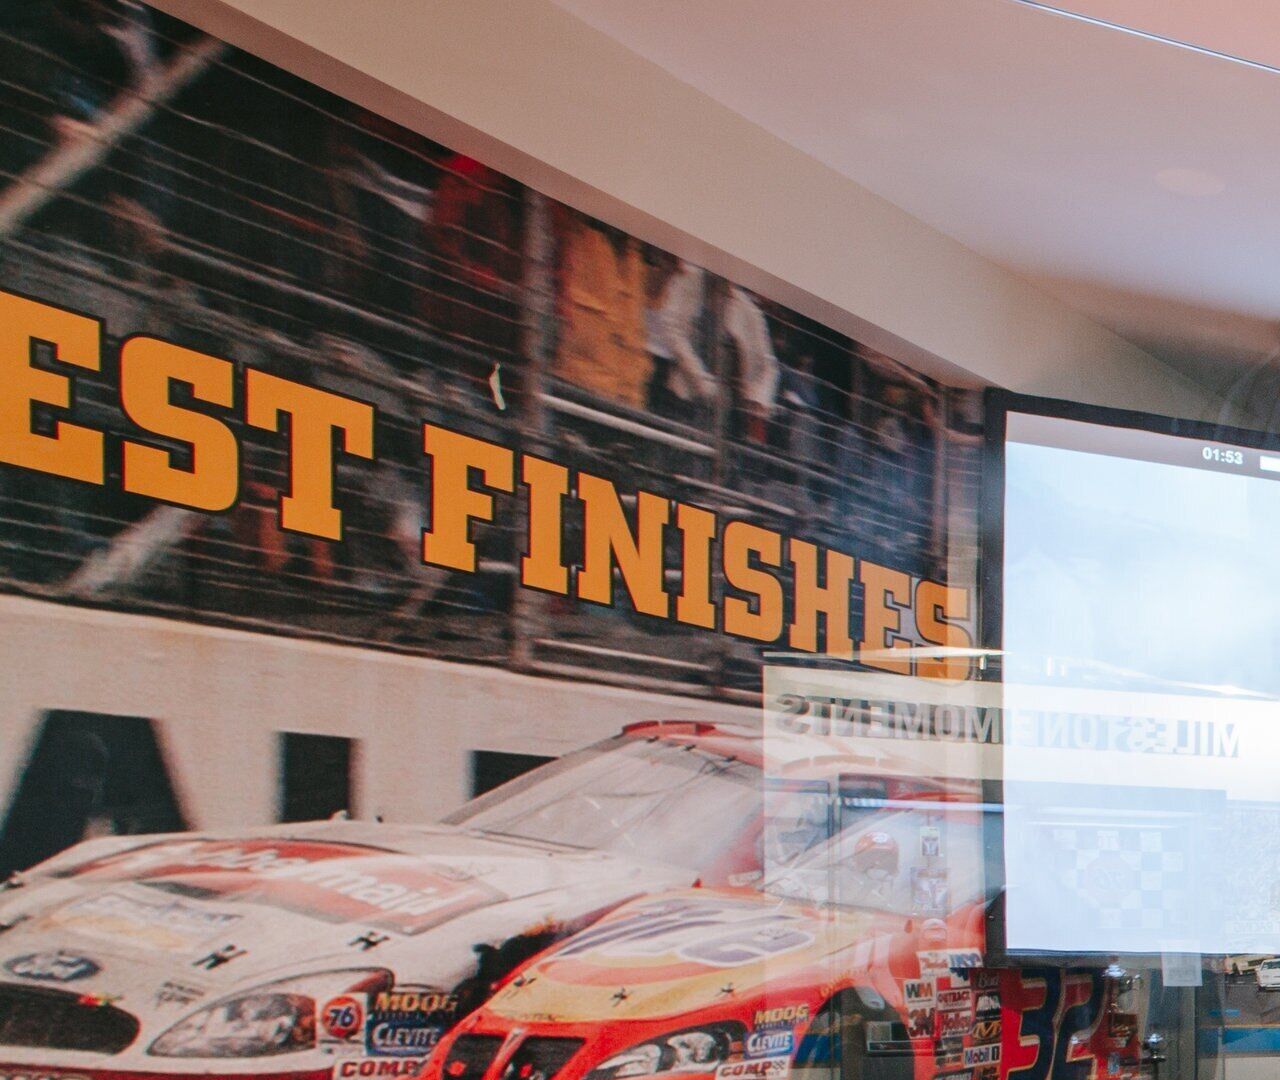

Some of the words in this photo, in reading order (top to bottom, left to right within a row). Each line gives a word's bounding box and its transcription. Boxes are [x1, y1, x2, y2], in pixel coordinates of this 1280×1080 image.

[1202, 447, 1243, 465] 01:53
[0, 287, 377, 544] EST
[421, 422, 975, 684] FINISHES
[375, 992, 458, 1012] MOOG
[329, 1007, 355, 1028] 76
[755, 1005, 810, 1025] MOOG
[340, 1061, 418, 1079] COMP
[719, 1062, 772, 1077] COMP
